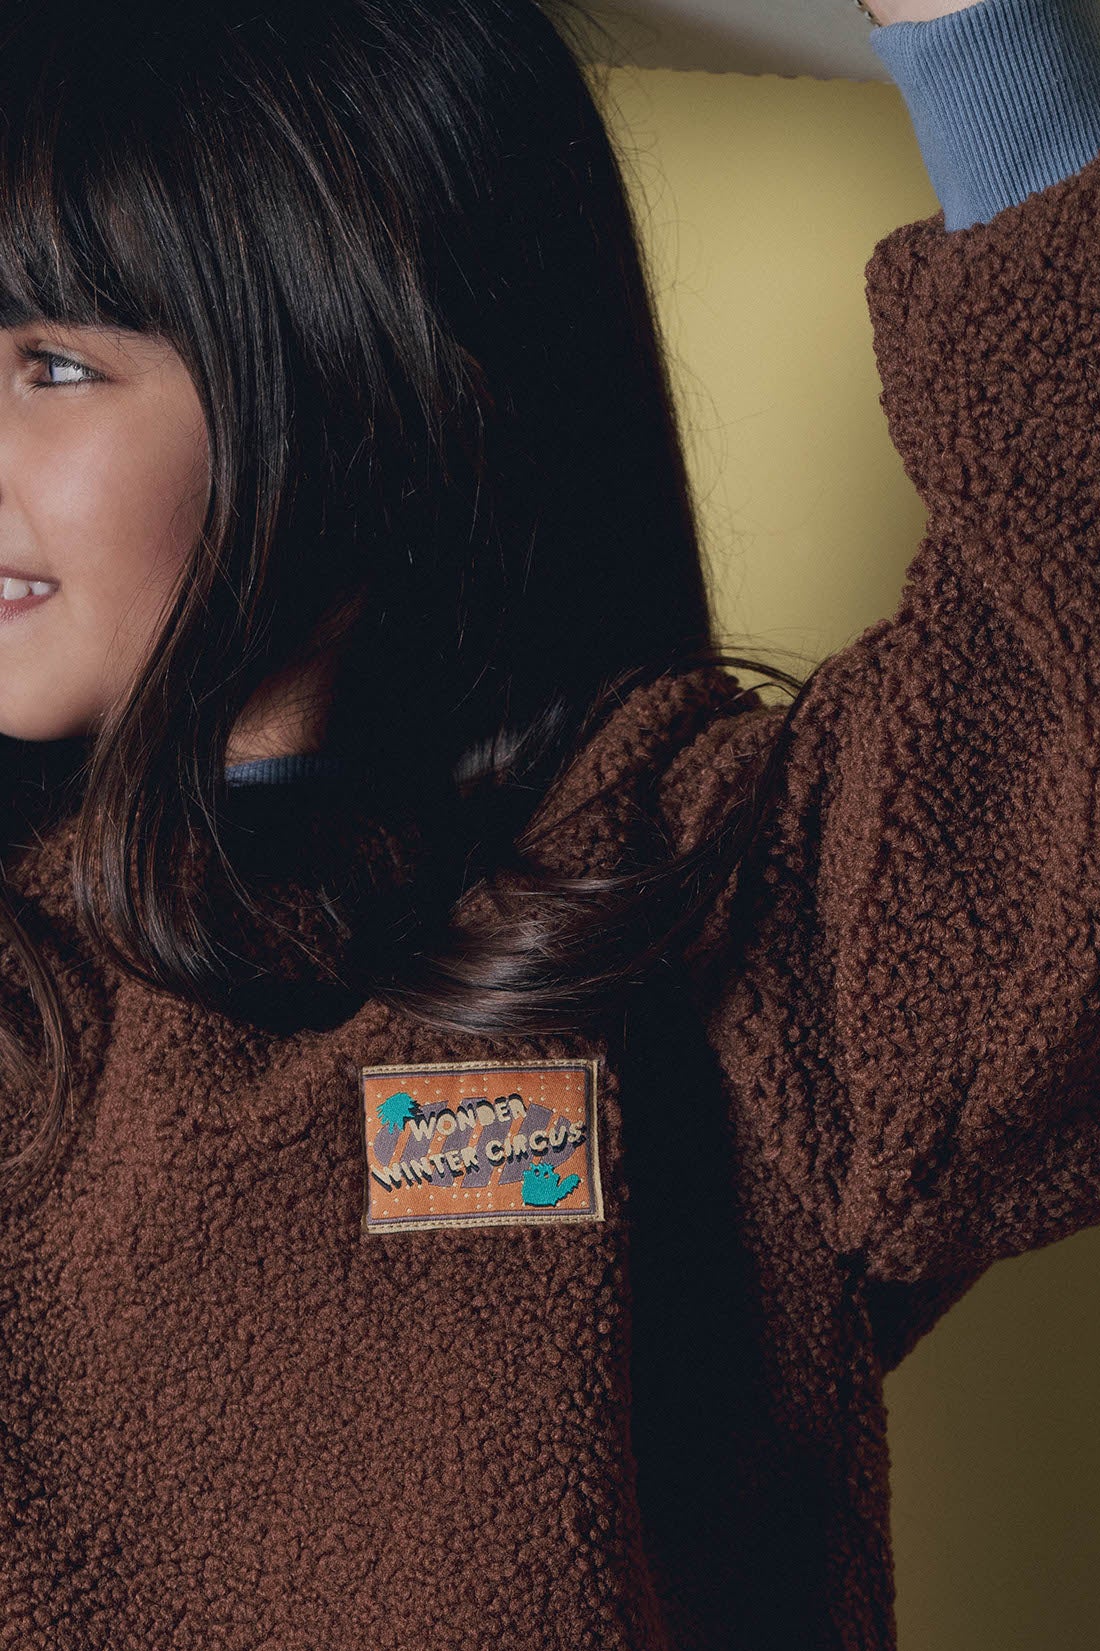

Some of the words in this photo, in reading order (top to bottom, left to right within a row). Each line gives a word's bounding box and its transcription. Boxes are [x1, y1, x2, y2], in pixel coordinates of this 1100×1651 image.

[405, 1094, 527, 1142] WONDER
[371, 1146, 479, 1192] WINTER
[485, 1120, 587, 1168] CIRCUS
